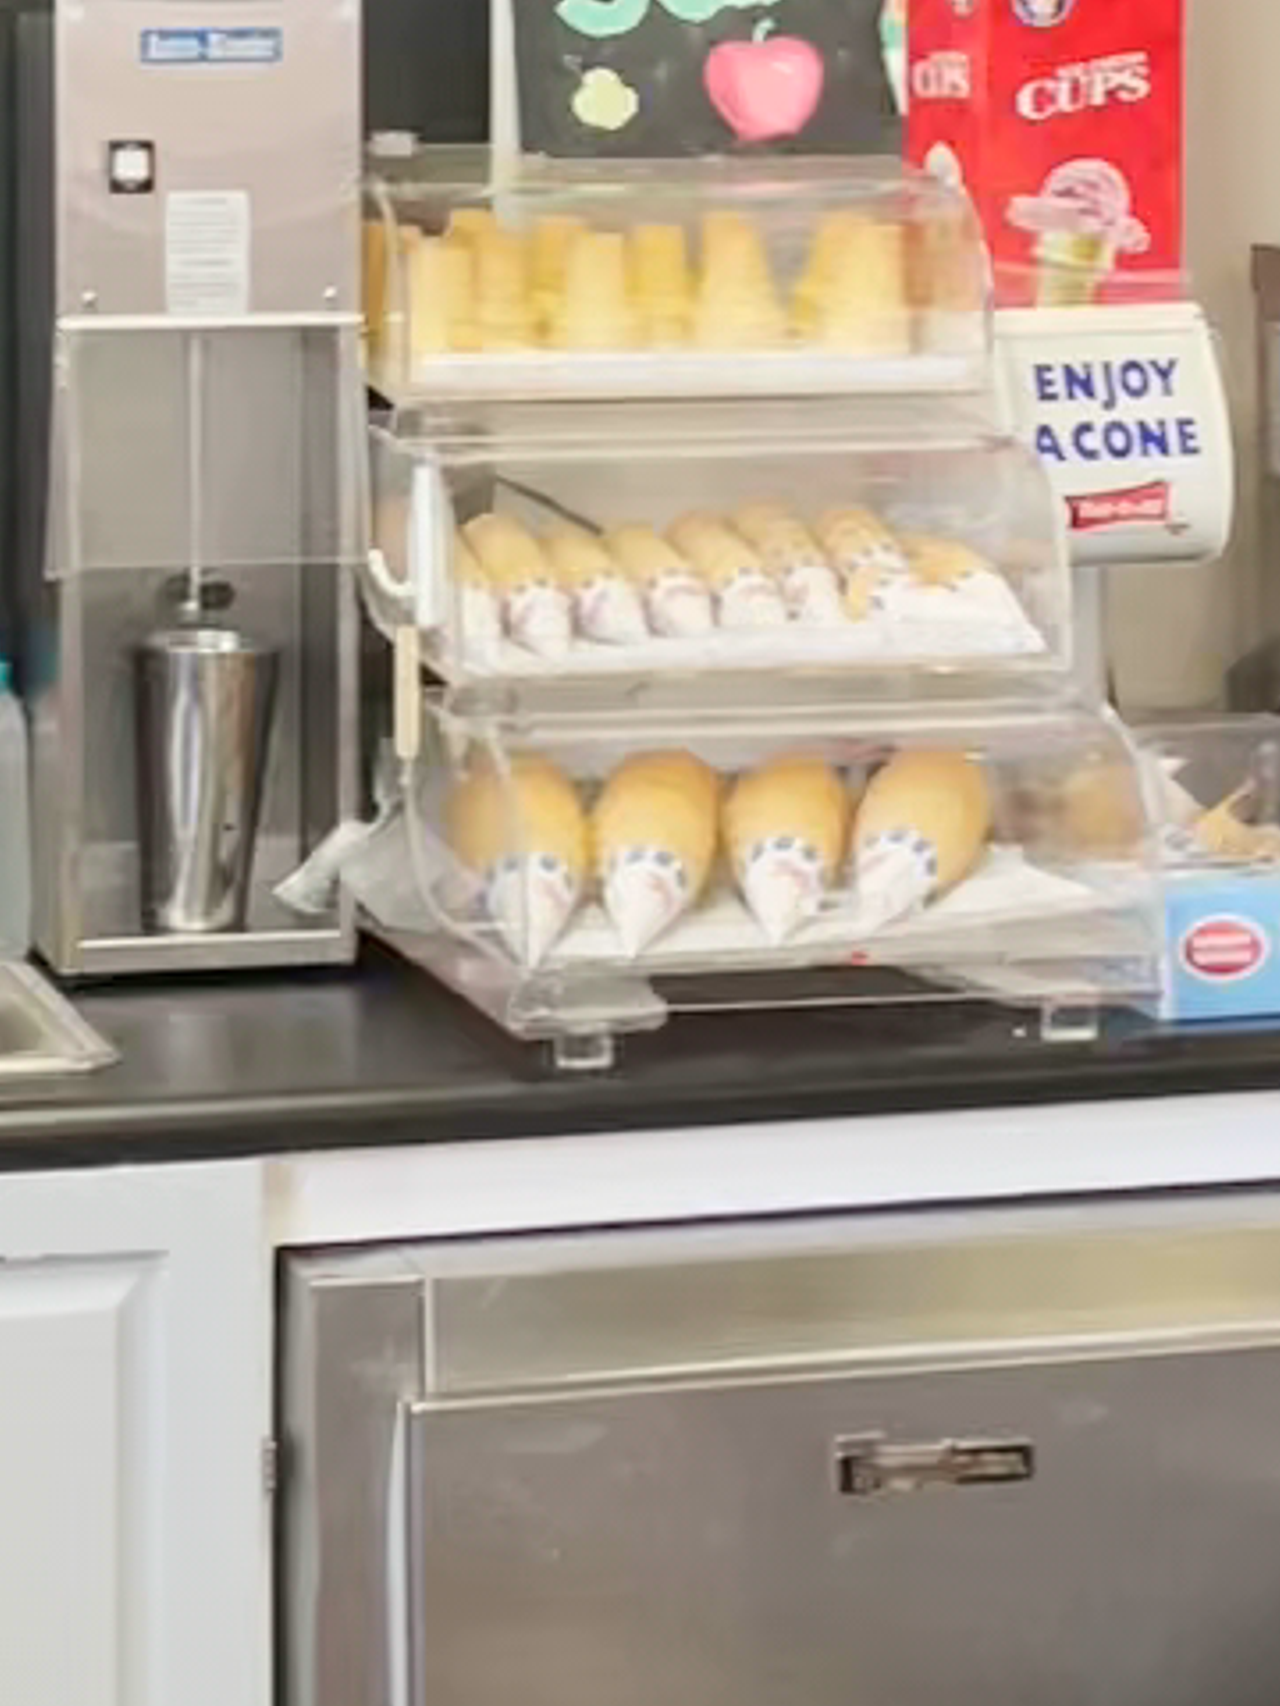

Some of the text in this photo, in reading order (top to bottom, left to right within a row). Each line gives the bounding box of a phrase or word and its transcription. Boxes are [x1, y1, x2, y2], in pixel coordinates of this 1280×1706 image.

[1016, 60, 1152, 120] CUPS
[1031, 356, 1179, 411] ENJOY
[1034, 417, 1201, 461] A CONE
